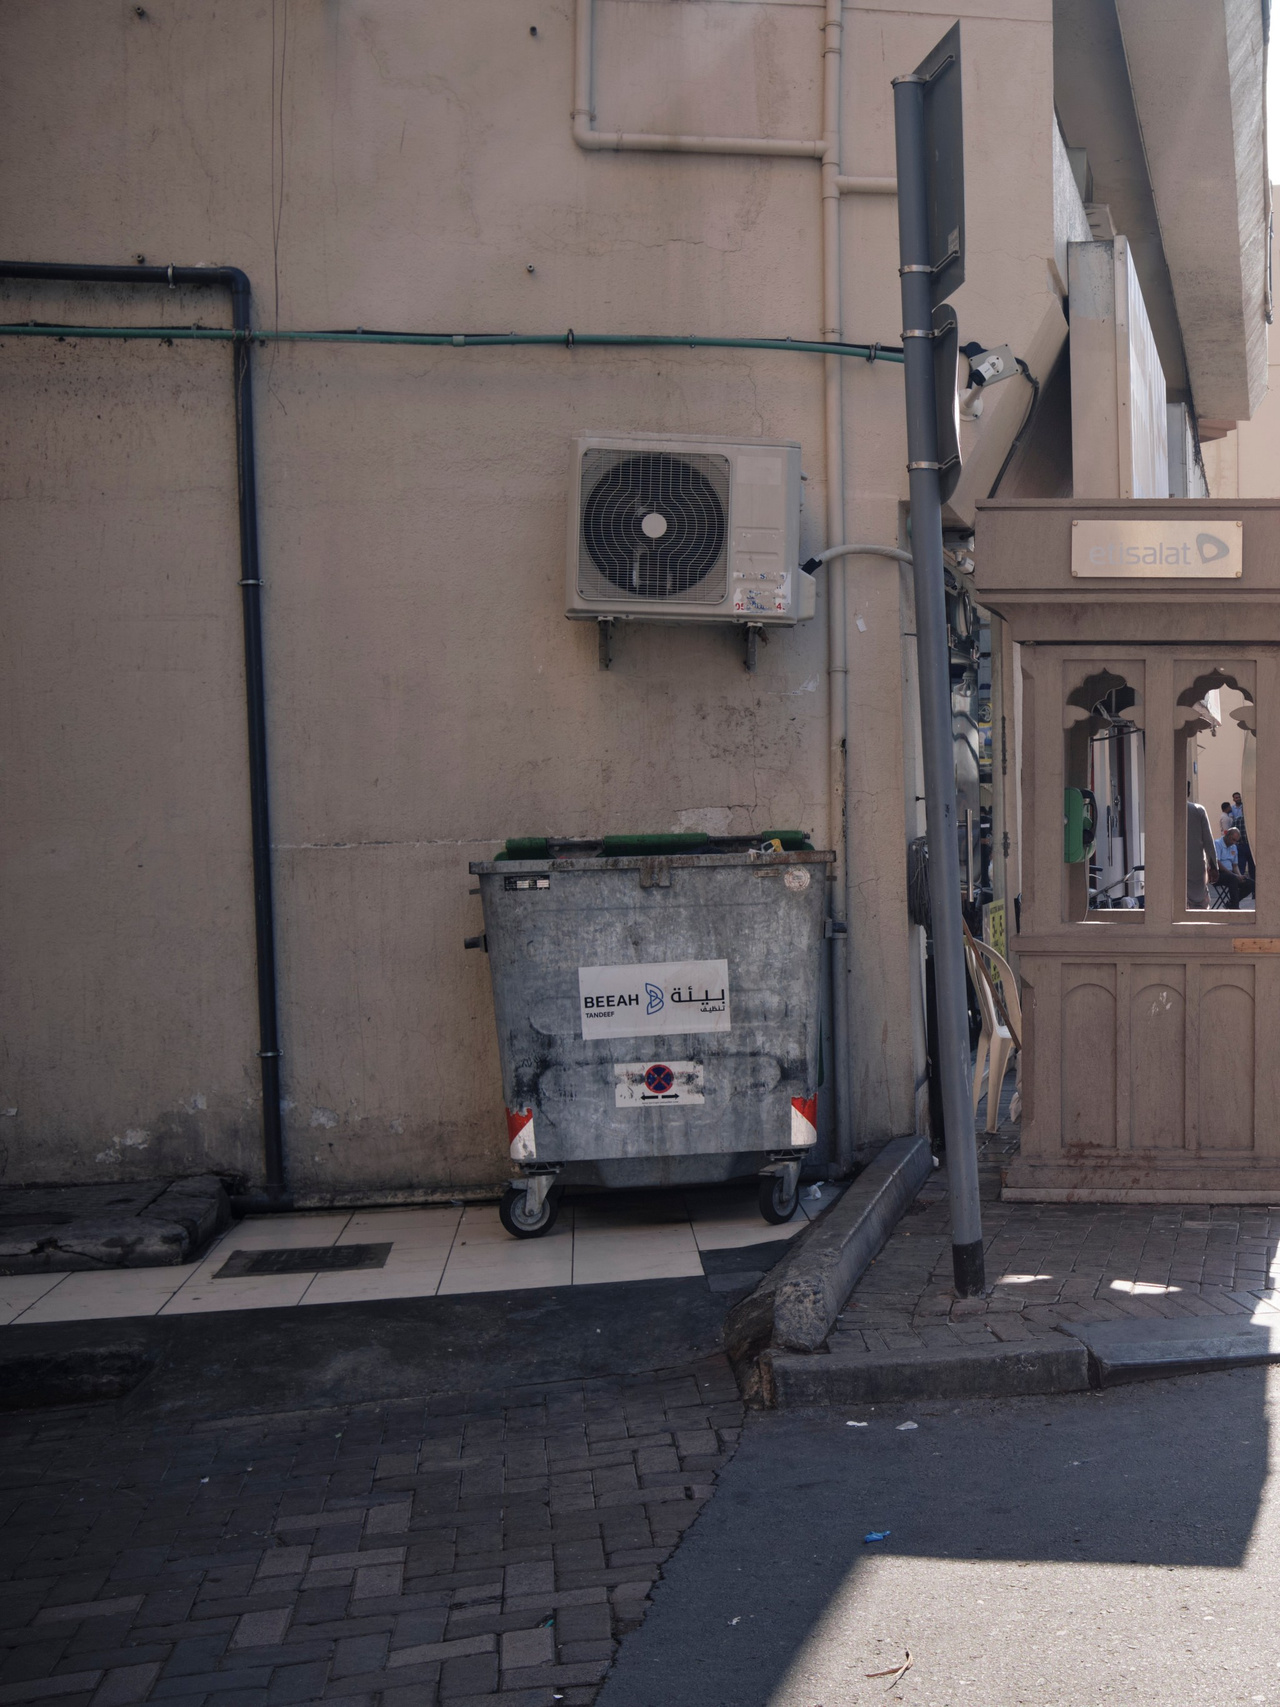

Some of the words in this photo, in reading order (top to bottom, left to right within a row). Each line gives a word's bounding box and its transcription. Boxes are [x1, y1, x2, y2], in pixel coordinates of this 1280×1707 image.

[1089, 542, 1191, 565] etisalat
[584, 994, 639, 1008] BEEAH
[670, 985, 725, 1005] بيئة
[585, 1011, 615, 1019] TANDEEF
[700, 1004, 725, 1014] تنظيف
